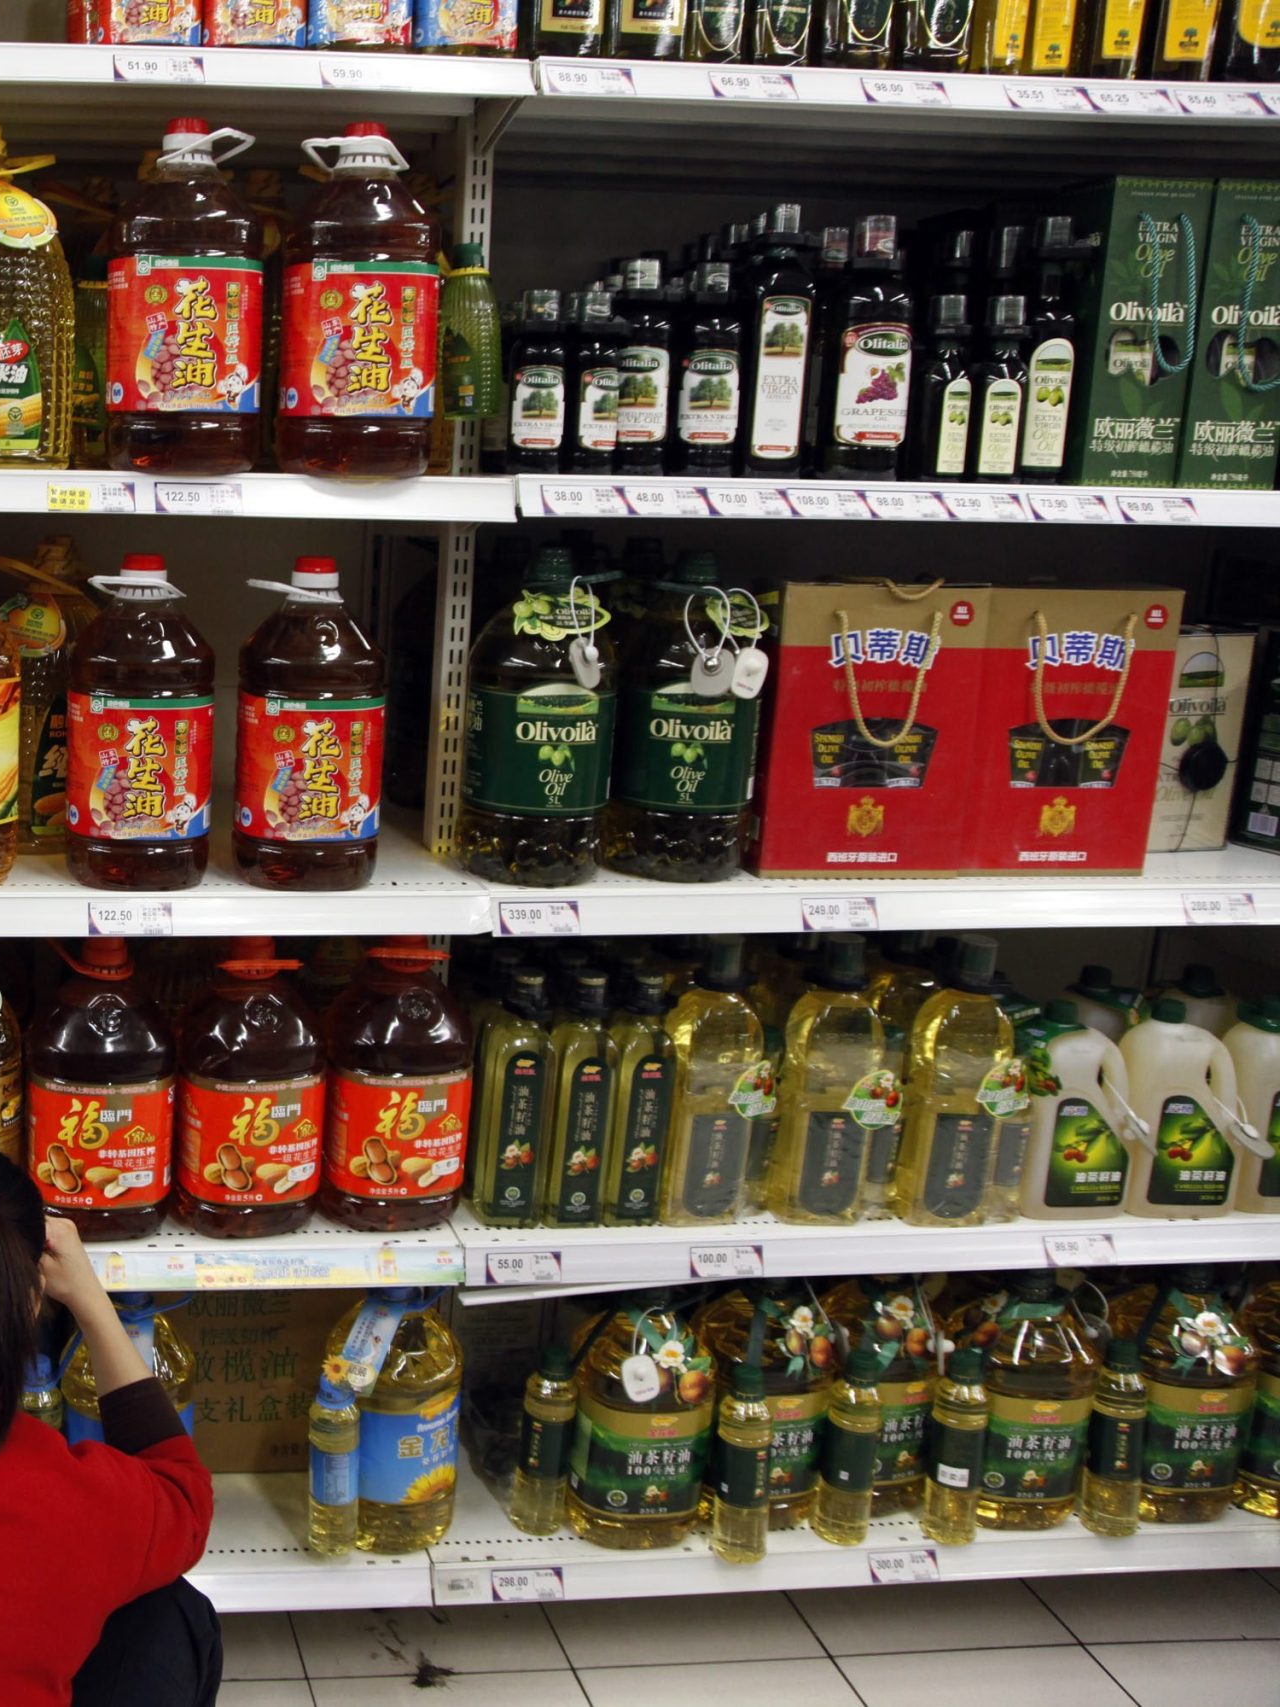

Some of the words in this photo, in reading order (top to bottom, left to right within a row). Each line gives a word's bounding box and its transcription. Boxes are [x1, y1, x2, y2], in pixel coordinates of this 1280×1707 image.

[127, 60, 158, 71] 51.90
[332, 68, 362, 79] 59.90
[172, 275, 219, 390] 花生油
[347, 280, 394, 394] 花生油
[859, 338, 910, 350] Olitalia
[691, 360, 734, 372] Olitalia
[523, 374, 560, 386] Olitalia
[762, 374, 798, 386] EXTRA
[760, 384, 799, 395] VIRGIN
[1093, 416, 1176, 441] 欧丽薇兰
[1193, 420, 1276, 444] 欧丽薇兰
[164, 490, 200, 503] 122.50
[554, 491, 582, 502] 38.00
[636, 492, 664, 503] 48.00
[720, 493, 748, 504] 70.00
[828, 628, 942, 670] 贝蒂斯
[1025, 631, 1135, 672] 贝蒂斯
[516, 720, 598, 742] Olivoilà
[649, 718, 733, 741] Olivoilà
[122, 716, 167, 819] 花生油
[298, 719, 343, 821] 花生油
[670, 766, 706, 780] Olive
[539, 768, 574, 783] Olive
[545, 781, 567, 797] Oil
[676, 778, 699, 794] Oil
[98, 909, 132, 922] 122.50
[508, 909, 542, 920] 339.00
[808, 904, 840, 916] 249.00
[497, 1258, 523, 1270] 55.00
[697, 1252, 727, 1265] 100.00
[1175, 1424, 1238, 1441] 油茶籽油
[1008, 1435, 1071, 1451] 油茶籽油
[627, 1448, 691, 1465] 油茶籽油
[876, 1559, 905, 1570] 300.00
[498, 1576, 528, 1588] 298.00
